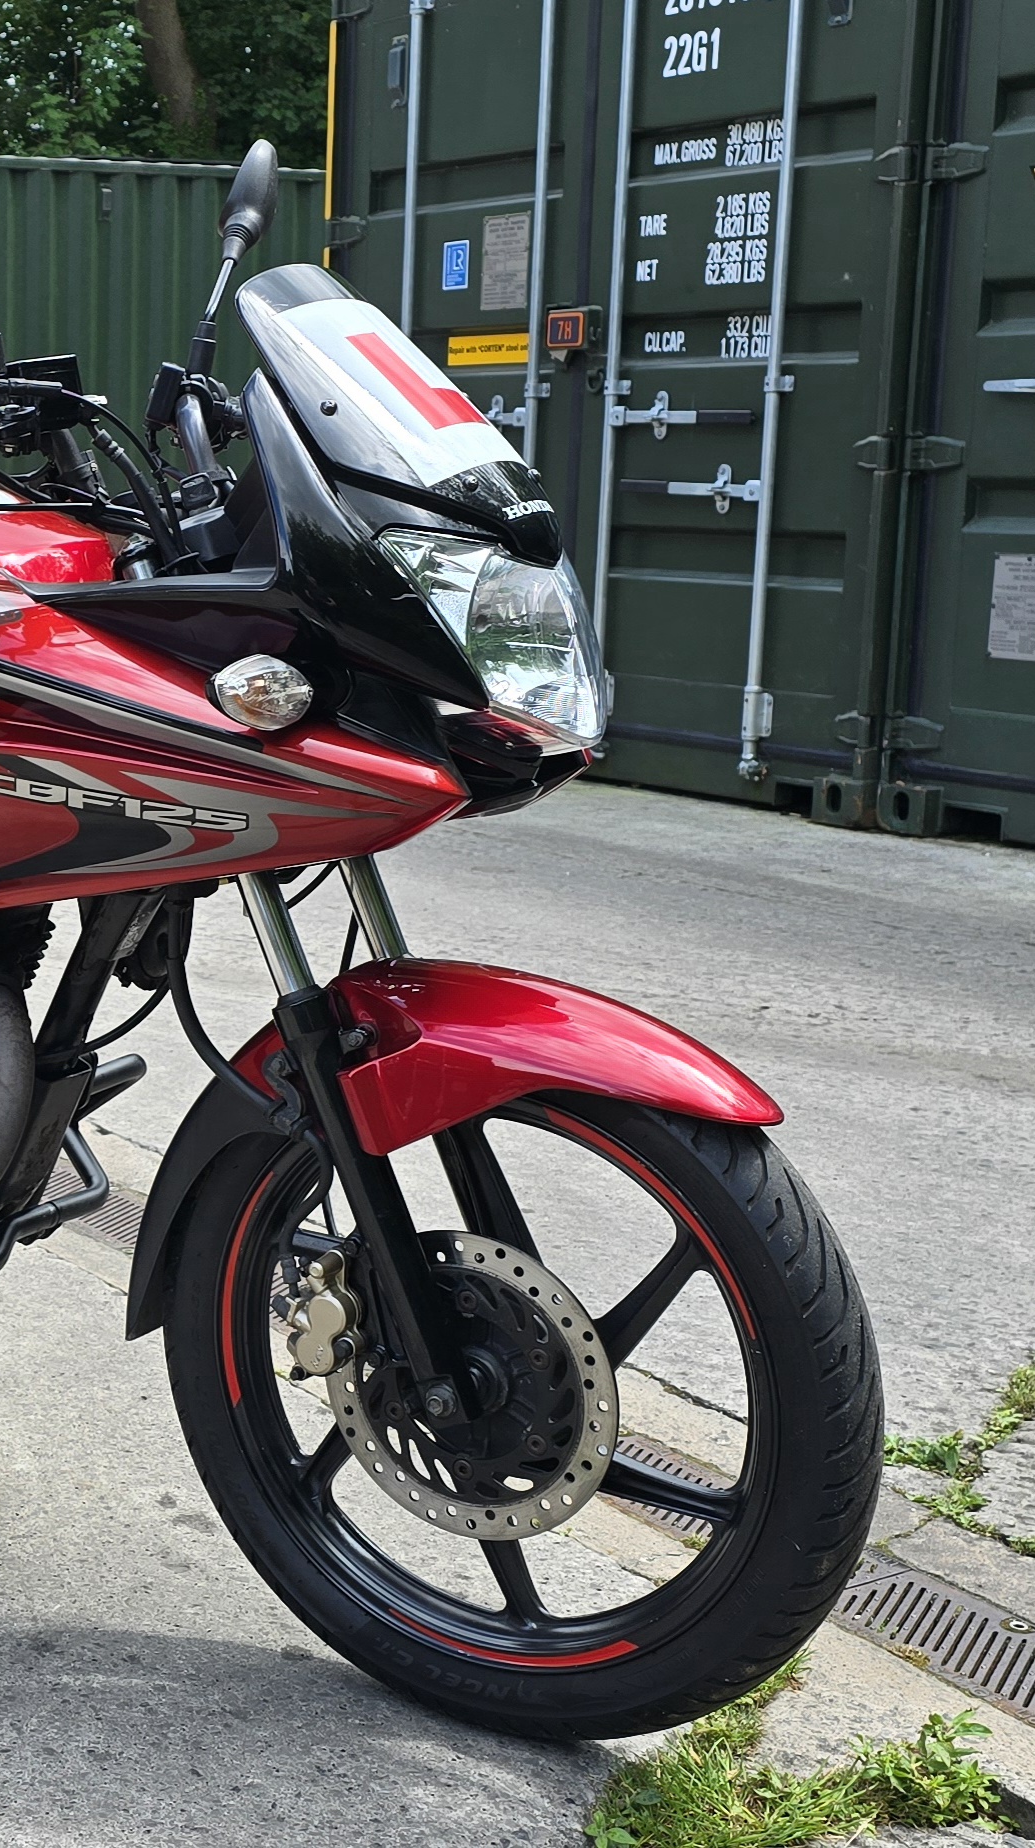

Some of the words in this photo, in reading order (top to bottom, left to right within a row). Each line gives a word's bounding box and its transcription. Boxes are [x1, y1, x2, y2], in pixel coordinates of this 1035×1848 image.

[663, 27, 721, 78] 22G1
[747, 191, 771, 214] KGS
[639, 214, 668, 237] TARE
[746, 213, 770, 236] LBS
[744, 238, 768, 261] KGS
[636, 259, 659, 282] NET
[743, 260, 766, 283] LBS
[449, 346, 465, 356] Repair
[466, 345, 477, 353] with
[344, 332, 490, 430] L
